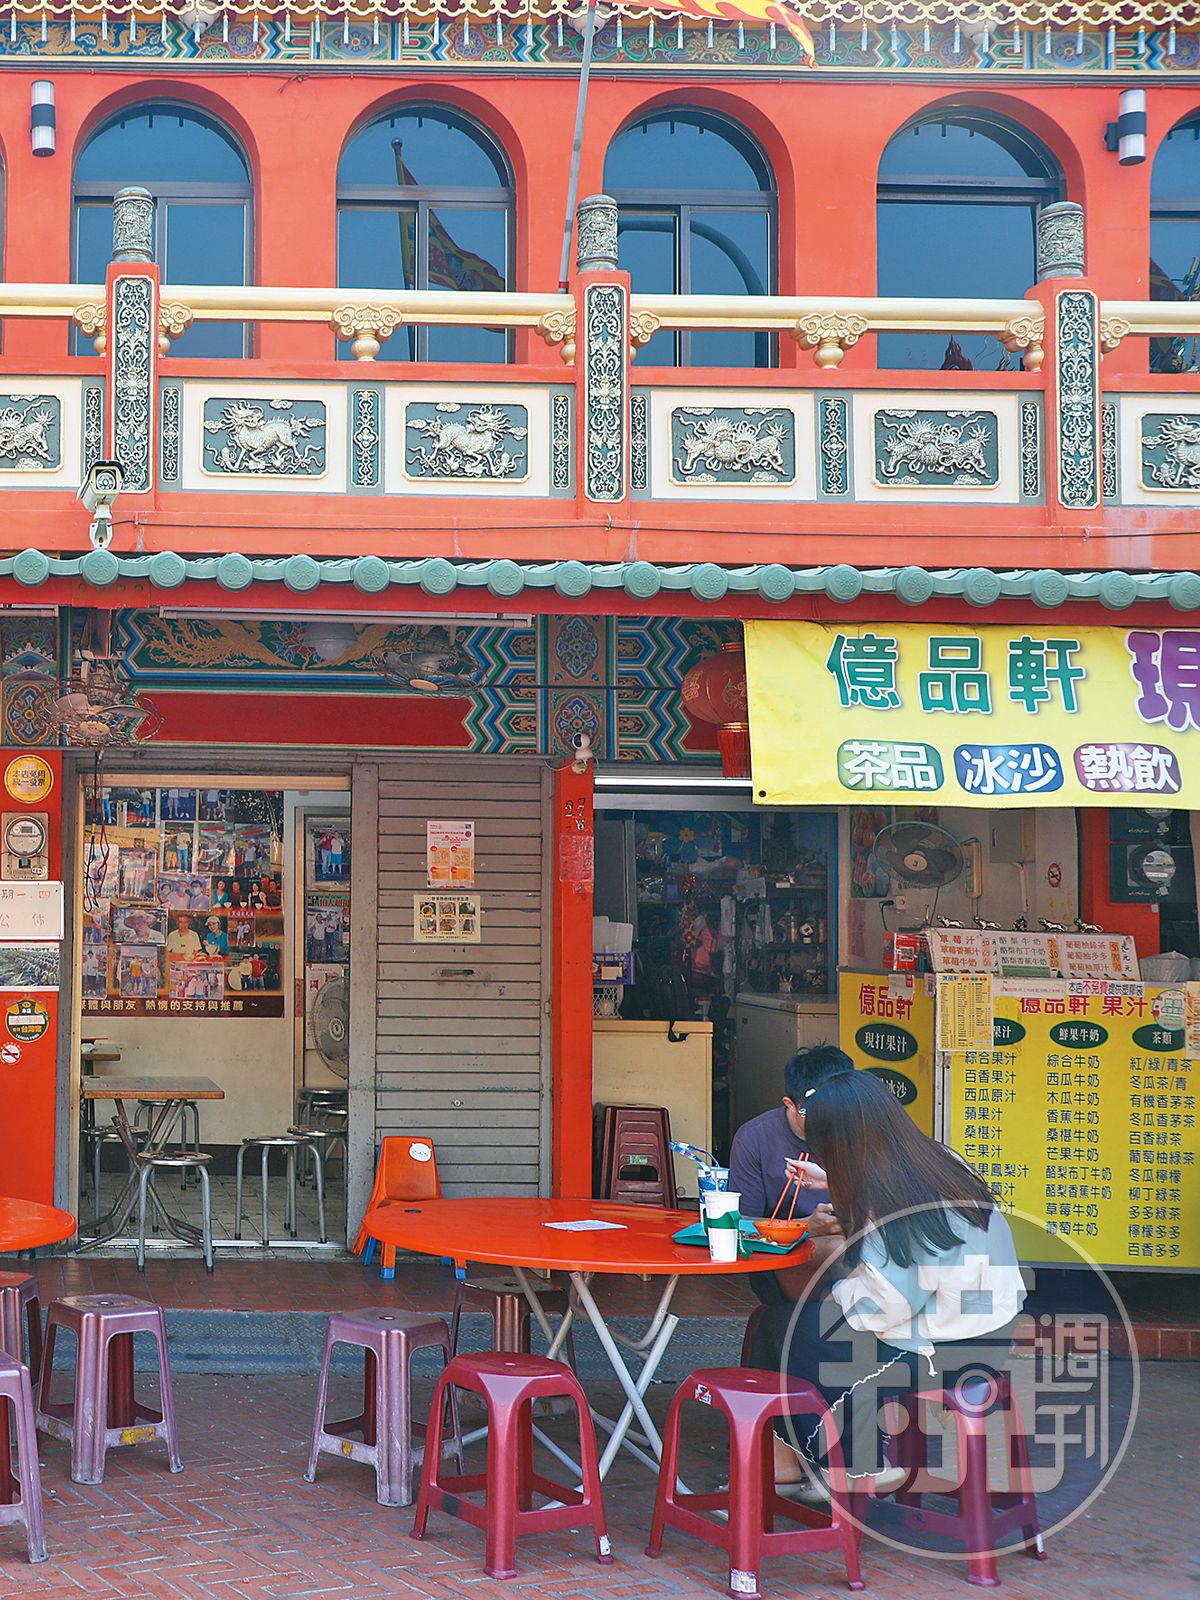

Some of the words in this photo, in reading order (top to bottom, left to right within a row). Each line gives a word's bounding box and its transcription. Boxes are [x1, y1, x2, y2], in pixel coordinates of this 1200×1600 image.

[825, 632, 1087, 714] 億品軒
[12, 769, 46, 779] 本店免用
[842, 741, 939, 791] 茶品
[959, 746, 1057, 794] 冰沙
[1079, 744, 1179, 792] 熱飲
[939, 935, 975, 946] 草莓汁
[999, 936, 1041, 946] 酪梨牛奶
[942, 957, 977, 967] 草莓牛奶
[859, 983, 914, 1021] 億品軒
[864, 1031, 907, 1053] 現打果汁
[1058, 1027, 1100, 1042] 鮮果牛奶
[1151, 1031, 1172, 1045] 茶類
[964, 1051, 1017, 1066] 綜合果汁
[1047, 1054, 1100, 1069] 綜合牛奶
[1130, 1056, 1193, 1072] 紅/綠/青茶
[965, 1069, 1017, 1084] 百香果汁
[1046, 1072, 1100, 1088] 西瓜牛奶
[1130, 1075, 1187, 1091] 冬瓜茶/青
[964, 1088, 1017, 1103] 西瓜原汁
[1046, 1090, 1100, 1106] 木瓜牛奶
[1130, 1094, 1196, 1109] 有機香茅茶
[964, 1106, 1003, 1121] 蘋果汁
[1046, 1109, 1100, 1125] 香蕉牛奶
[1130, 1112, 1196, 1128] 冬瓜香茅茶
[1129, 1130, 1182, 1146] 百香綠茶
[964, 1143, 1003, 1158] 芒果汁
[1046, 1146, 1099, 1162] 芒果牛奶
[1129, 1148, 1195, 1165] 葡萄柚綠茶
[968, 1162, 1030, 1178] 果鳳梨汁
[1045, 1165, 1113, 1181] 酪梨布丁牛奶
[1129, 1168, 1182, 1184] 冬瓜檸檬
[986, 1181, 1016, 1196] 萄汁
[1045, 1183, 1112, 1199] 酪梨香蕉牛奶
[1129, 1186, 1181, 1202] 柳丁綠茶
[1045, 1202, 1099, 1218] 草莓牛奶
[1128, 1205, 1181, 1220] 多多綠茶
[1045, 1221, 1099, 1237] 葡萄牛奶
[1128, 1224, 1181, 1239] 檸檬多多
[1128, 1242, 1181, 1258] 百香多多
